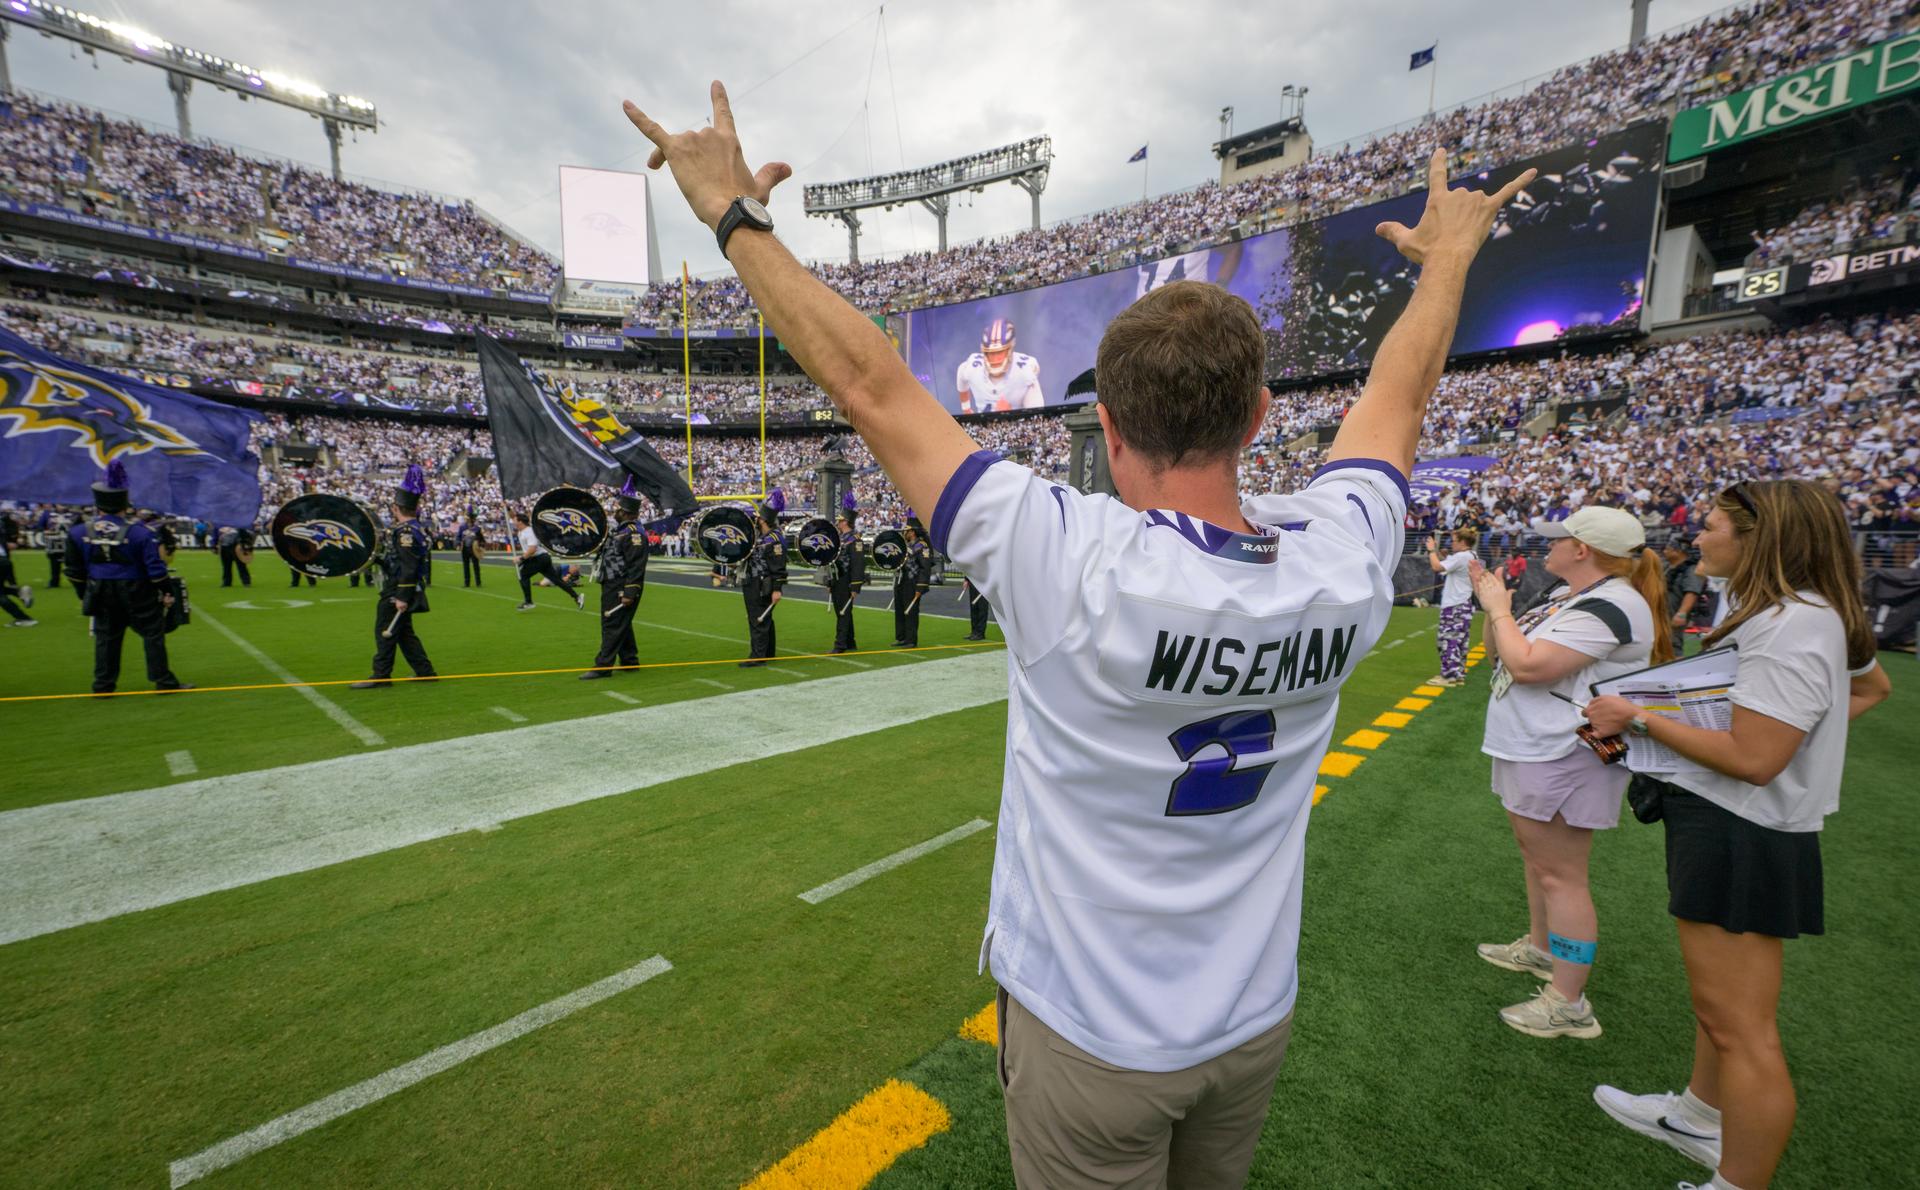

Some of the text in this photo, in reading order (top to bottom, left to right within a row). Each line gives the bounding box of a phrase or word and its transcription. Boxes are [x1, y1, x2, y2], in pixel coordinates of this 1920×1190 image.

[1701, 49, 1874, 149] M&T
[1744, 271, 1780, 297] 25
[587, 336, 617, 346] merritt
[815, 410, 833, 421] 8:52
[1241, 542, 1279, 554] RAVE
[1145, 623, 1358, 696] WISEMAN
[1164, 708, 1279, 817] 2
